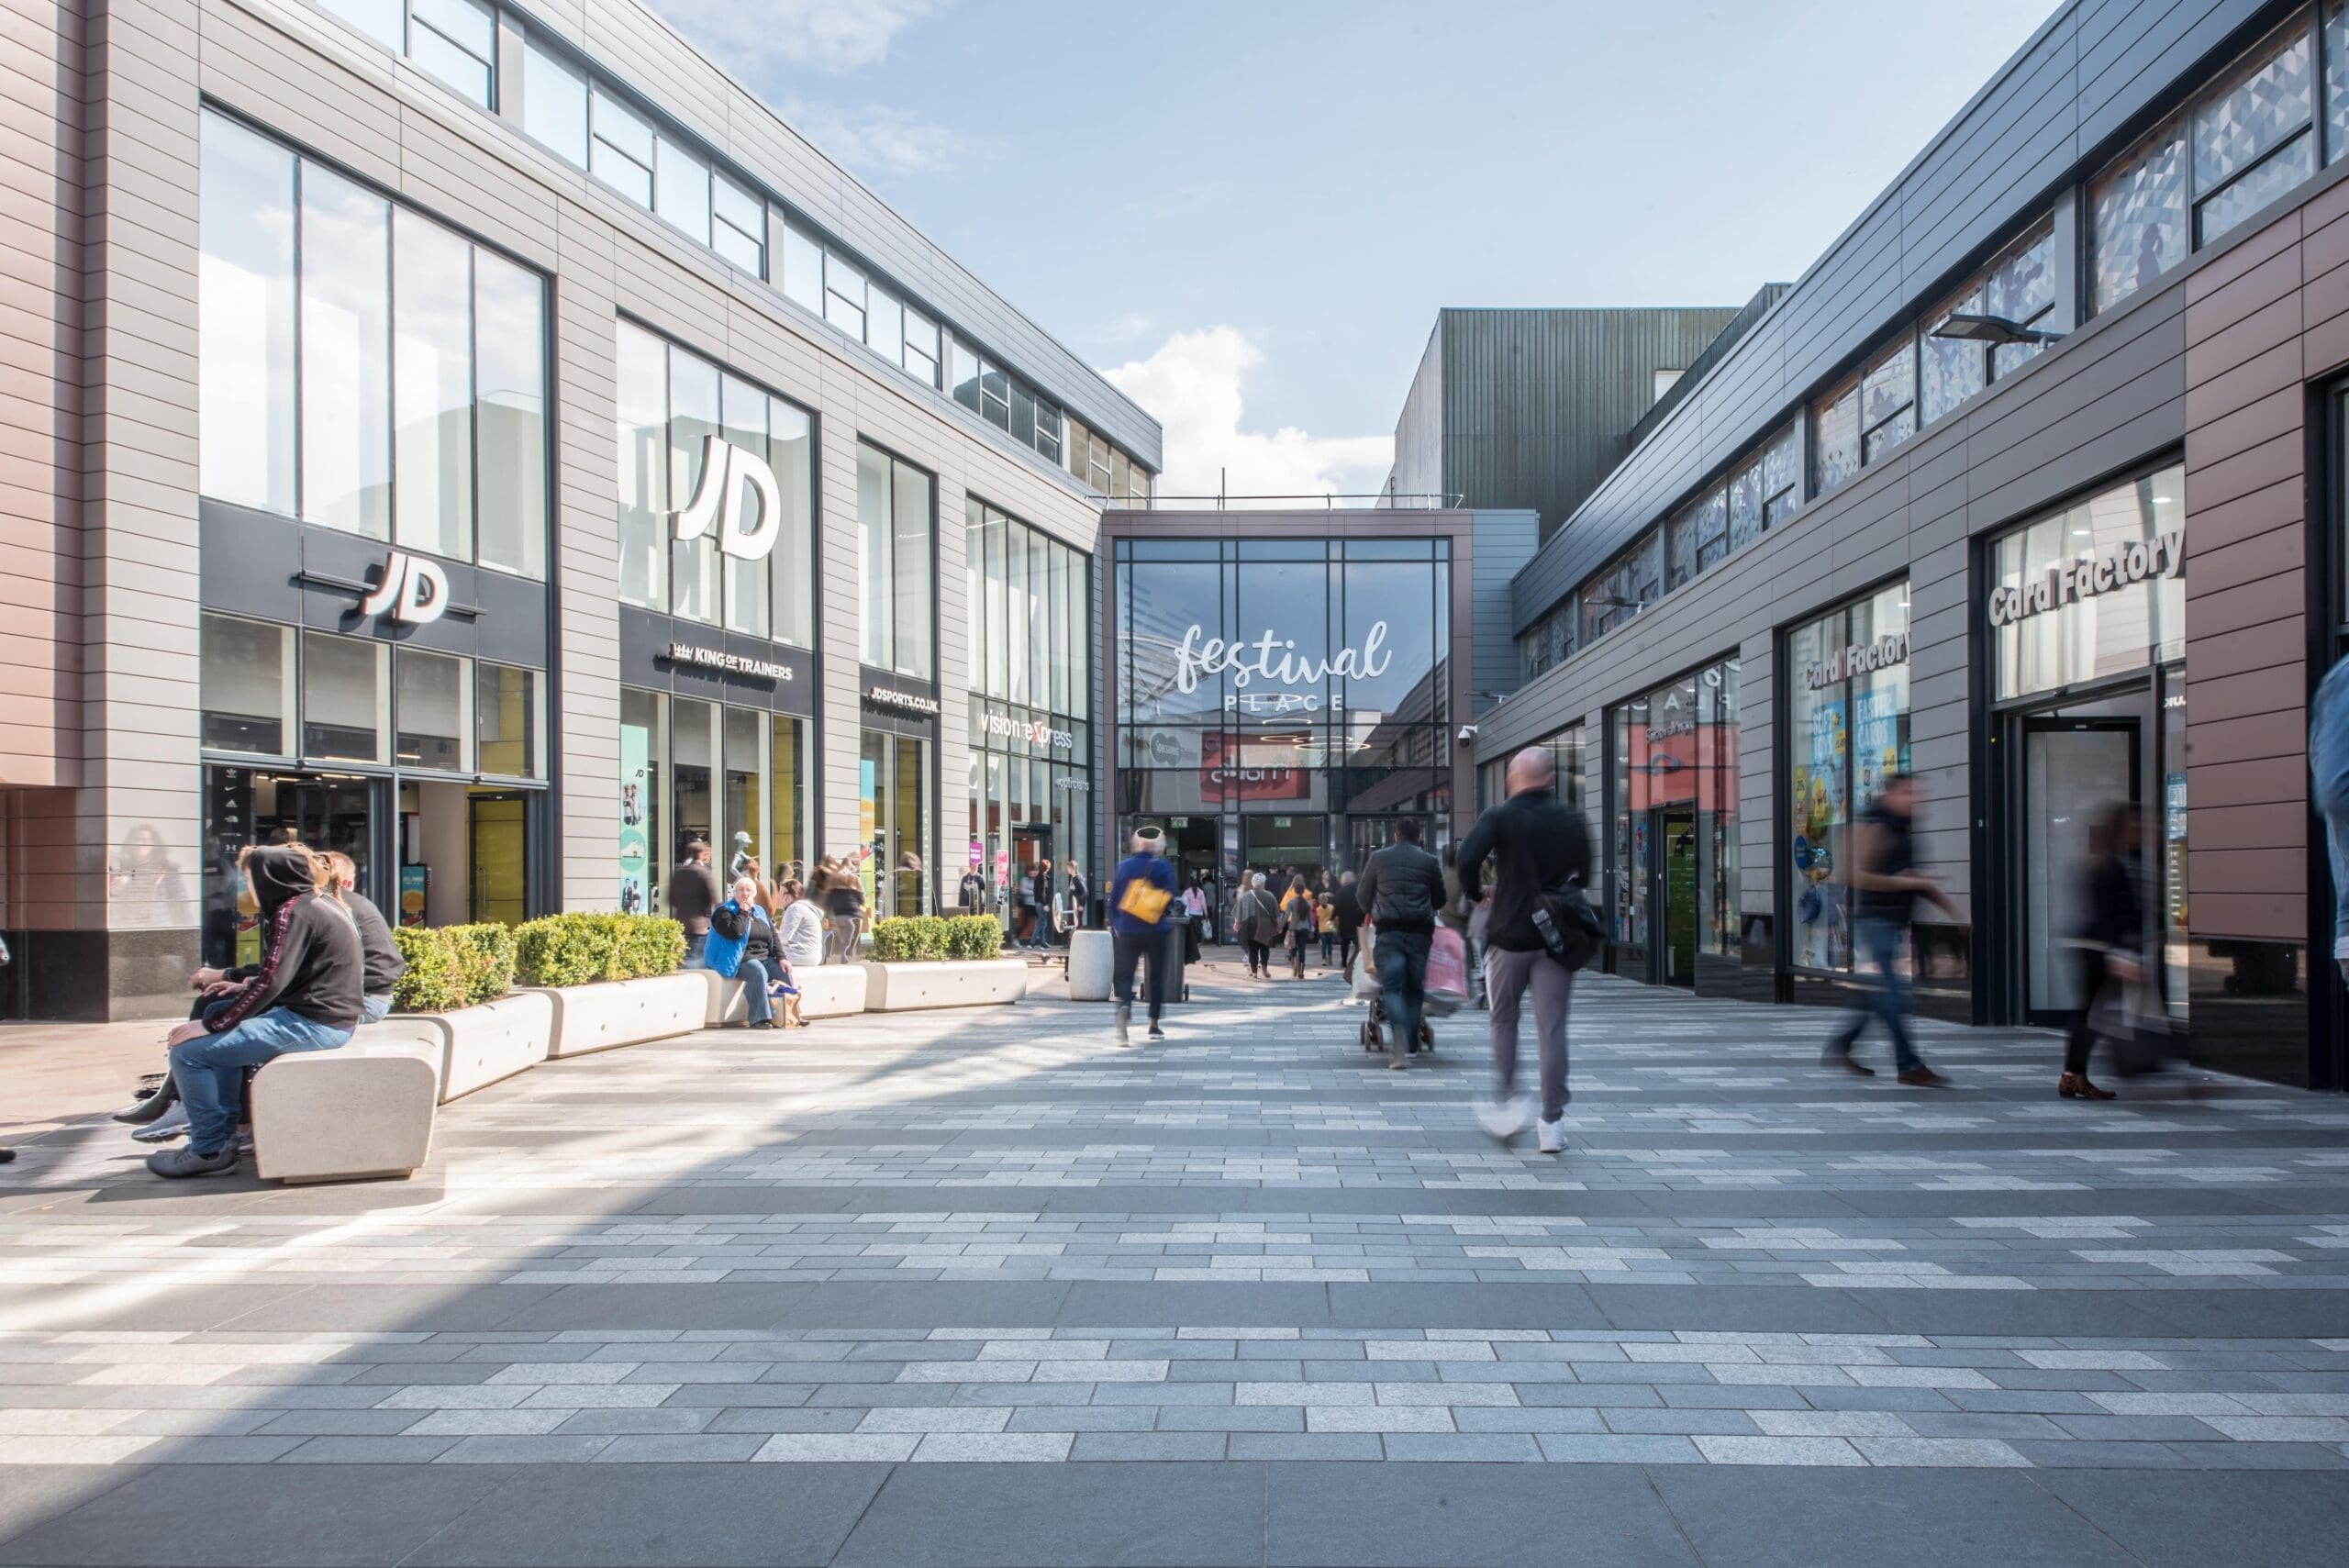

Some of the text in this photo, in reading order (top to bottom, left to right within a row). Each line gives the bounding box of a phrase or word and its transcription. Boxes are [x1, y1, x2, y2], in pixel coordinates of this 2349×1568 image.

[673, 434, 781, 562] JD
[363, 550, 450, 624] JD
[1987, 528, 2186, 627] Card Factory
[695, 646, 792, 680] KING OF TRAINERS
[1174, 621, 1392, 694] festival
[1805, 651, 1840, 688] Card
[871, 686, 939, 713] JDSPORTS.CO.UK
[1224, 695, 1343, 711] PLACE
[980, 709, 1072, 749] vision express
